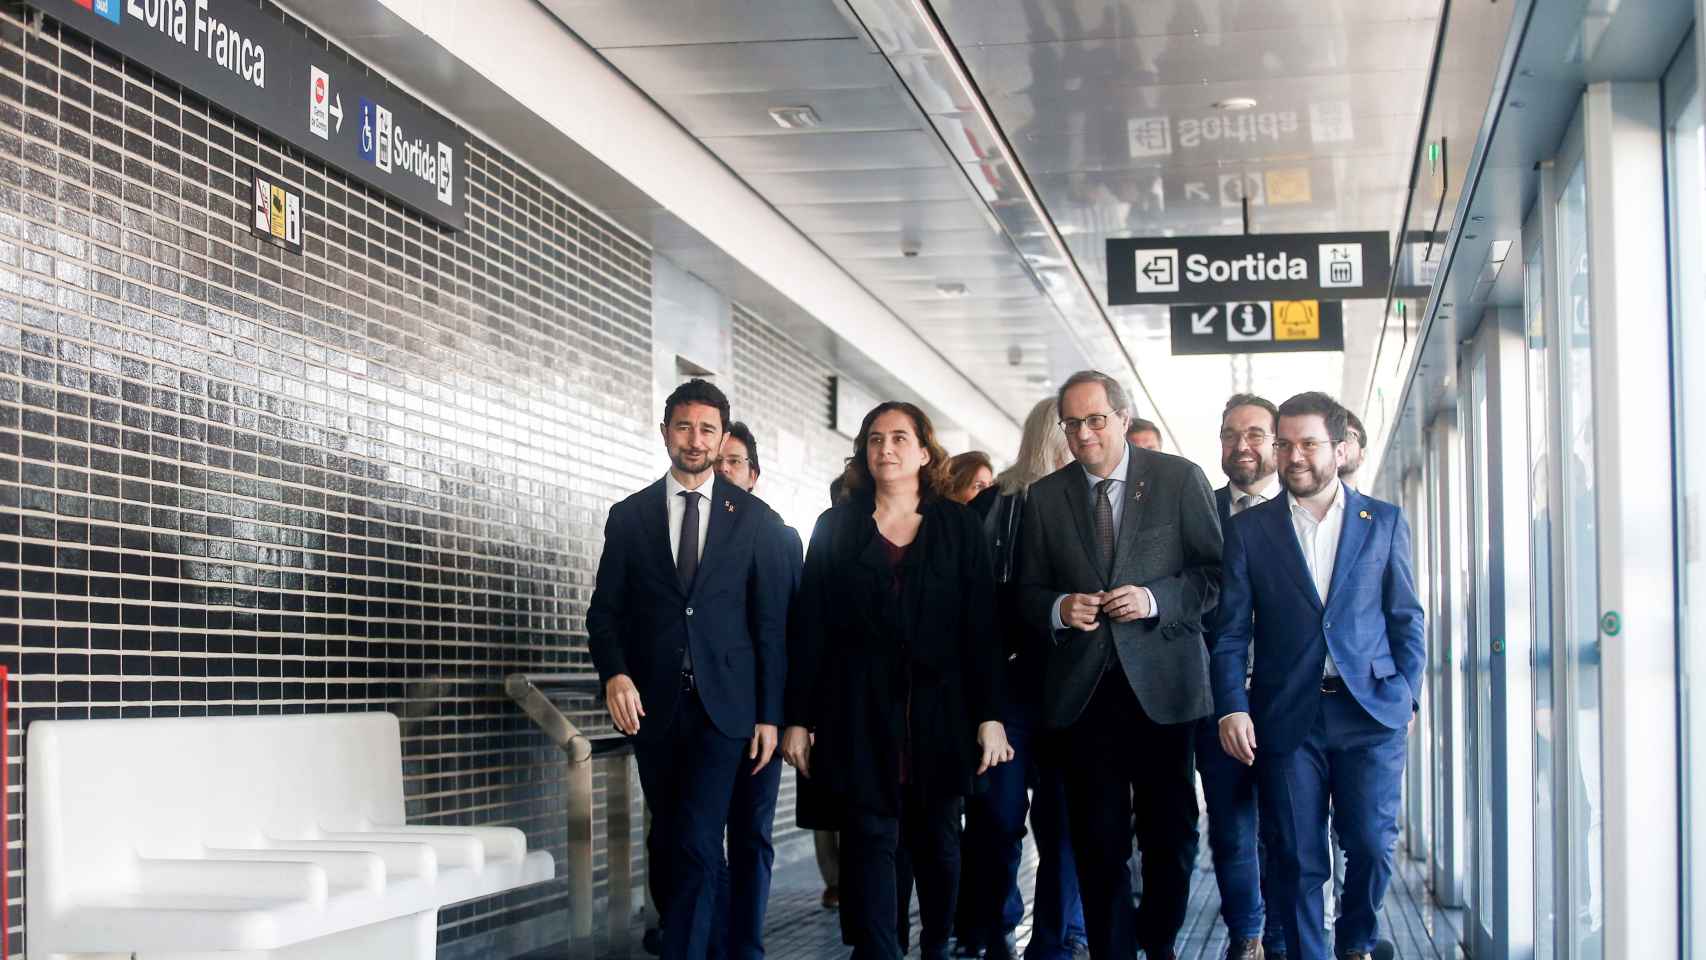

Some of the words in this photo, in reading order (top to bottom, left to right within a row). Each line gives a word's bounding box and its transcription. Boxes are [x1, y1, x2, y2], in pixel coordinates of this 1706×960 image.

[194, 0, 265, 89] Franca
[393, 125, 436, 185] Sortida
[1185, 252, 1309, 283] Sortida
